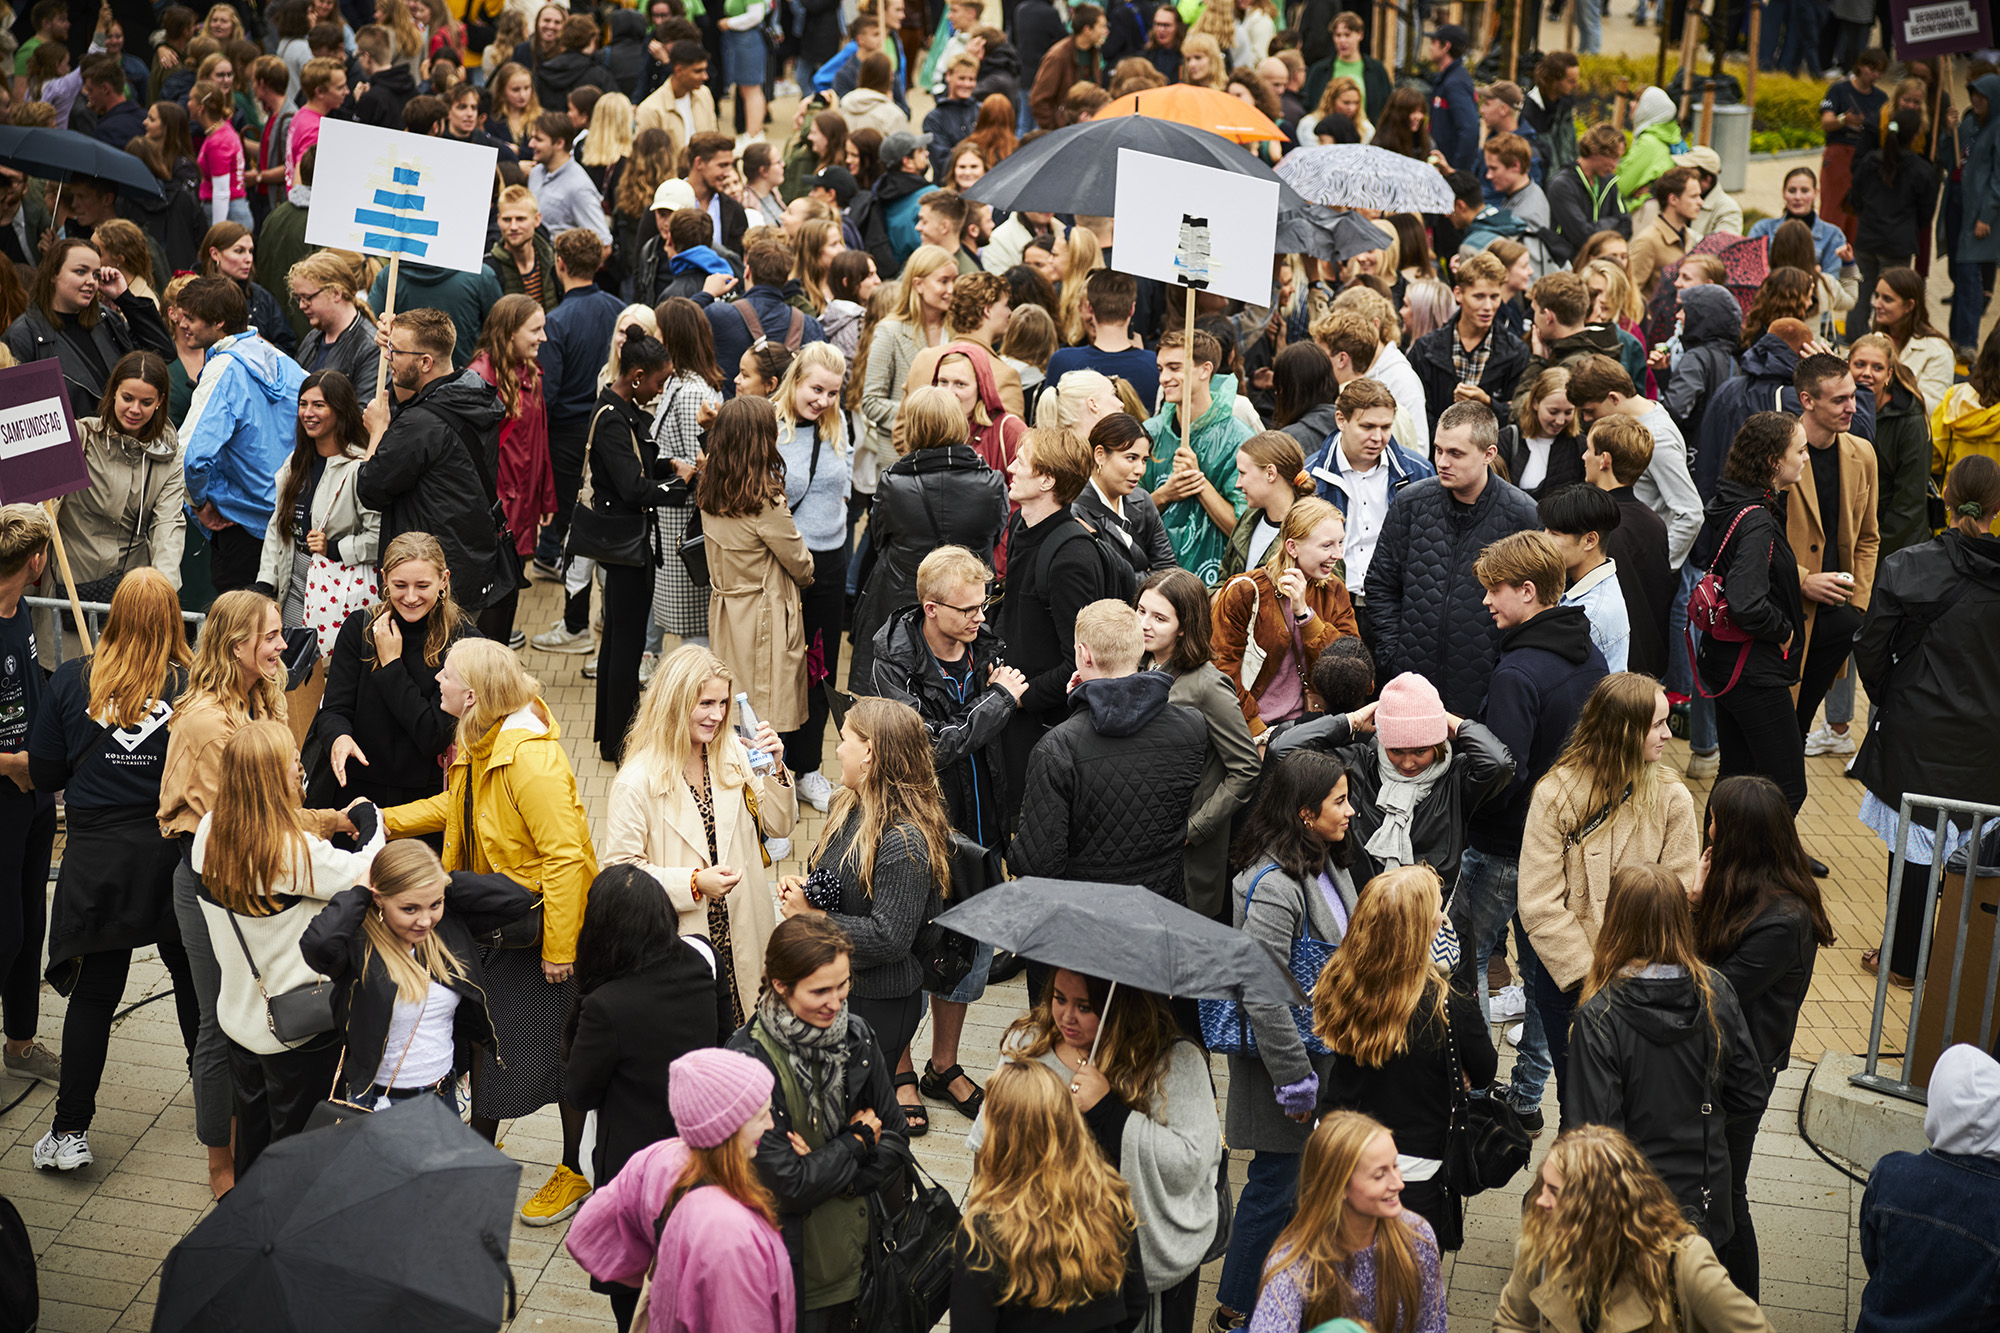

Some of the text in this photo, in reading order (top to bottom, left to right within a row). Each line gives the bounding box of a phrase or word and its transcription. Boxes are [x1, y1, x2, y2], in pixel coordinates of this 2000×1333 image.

[1911, 17, 1974, 37] GEOINFORMATIK
[0, 411, 62, 445] SAMFUNDSFAG
[105, 752, 158, 761] KØBENHAVNS
